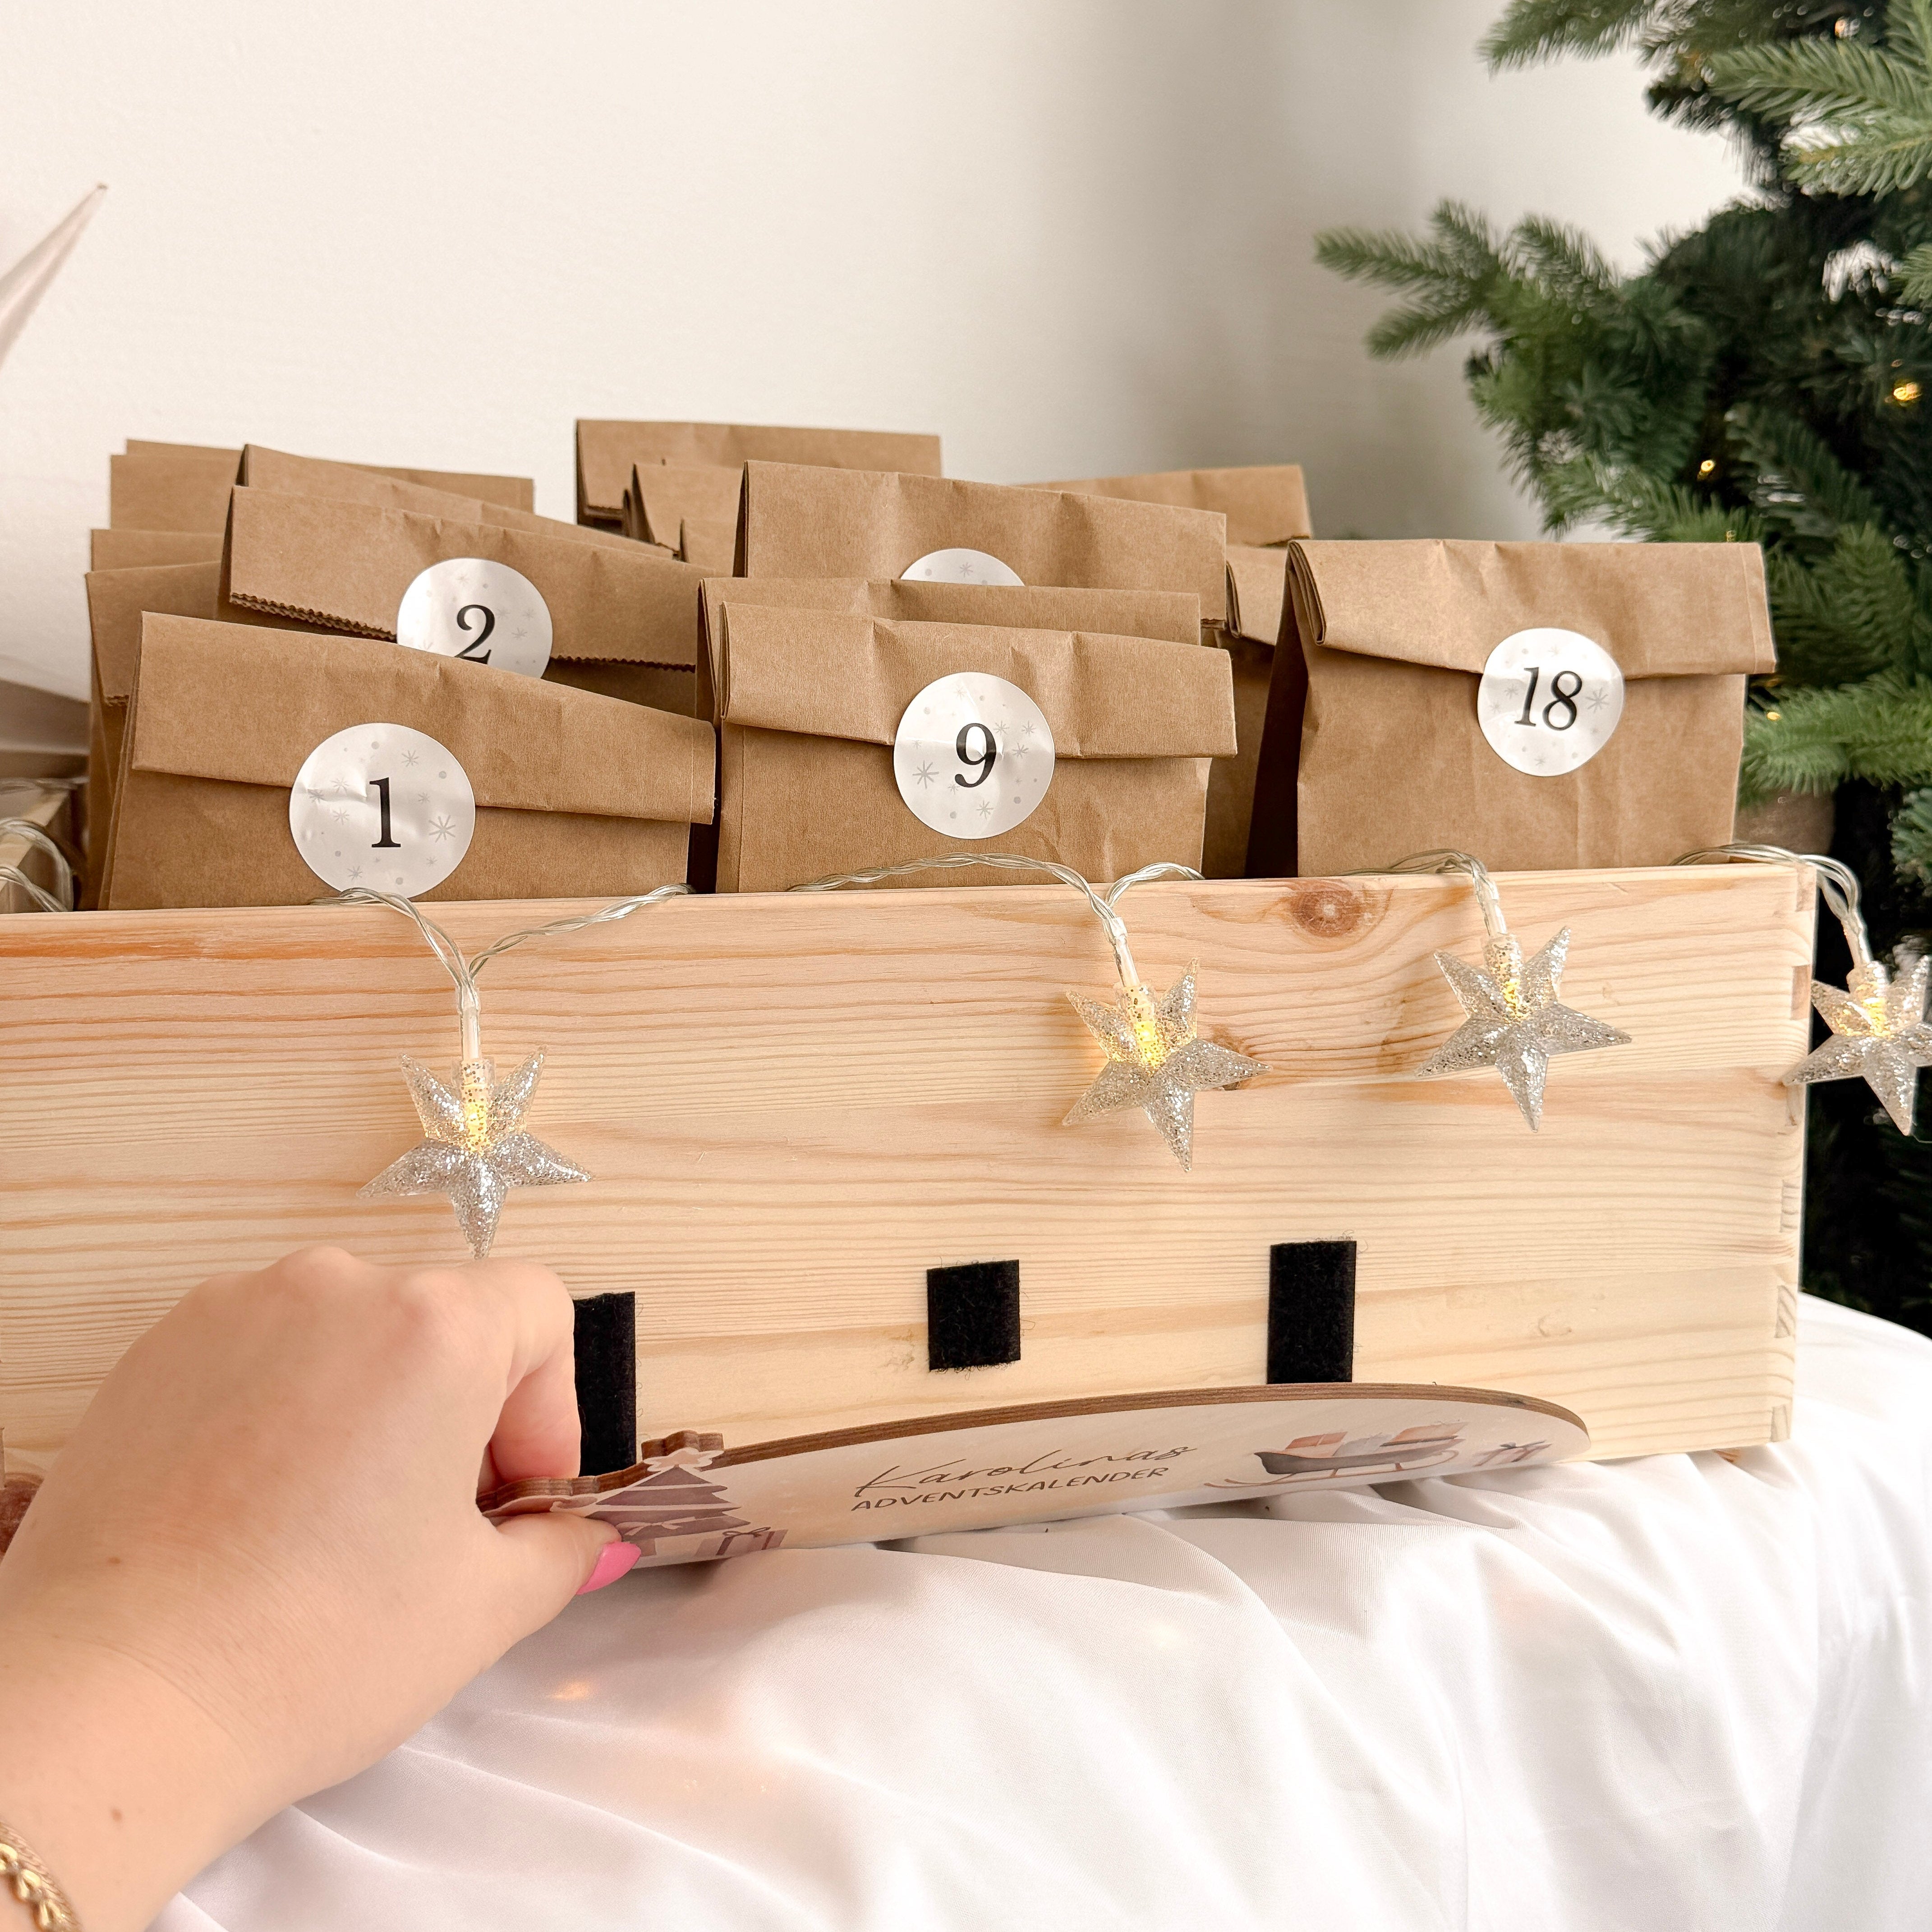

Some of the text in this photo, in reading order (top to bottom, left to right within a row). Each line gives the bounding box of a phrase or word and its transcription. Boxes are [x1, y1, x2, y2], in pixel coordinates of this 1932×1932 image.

[454, 604, 495, 664] 2
[1514, 667, 1582, 731] 18
[955, 722, 996, 788] 9
[369, 777, 401, 848] 1
[851, 1467, 1169, 1511] ADVENTSKALENDER
[854, 1445, 1197, 1498] Karolinas
